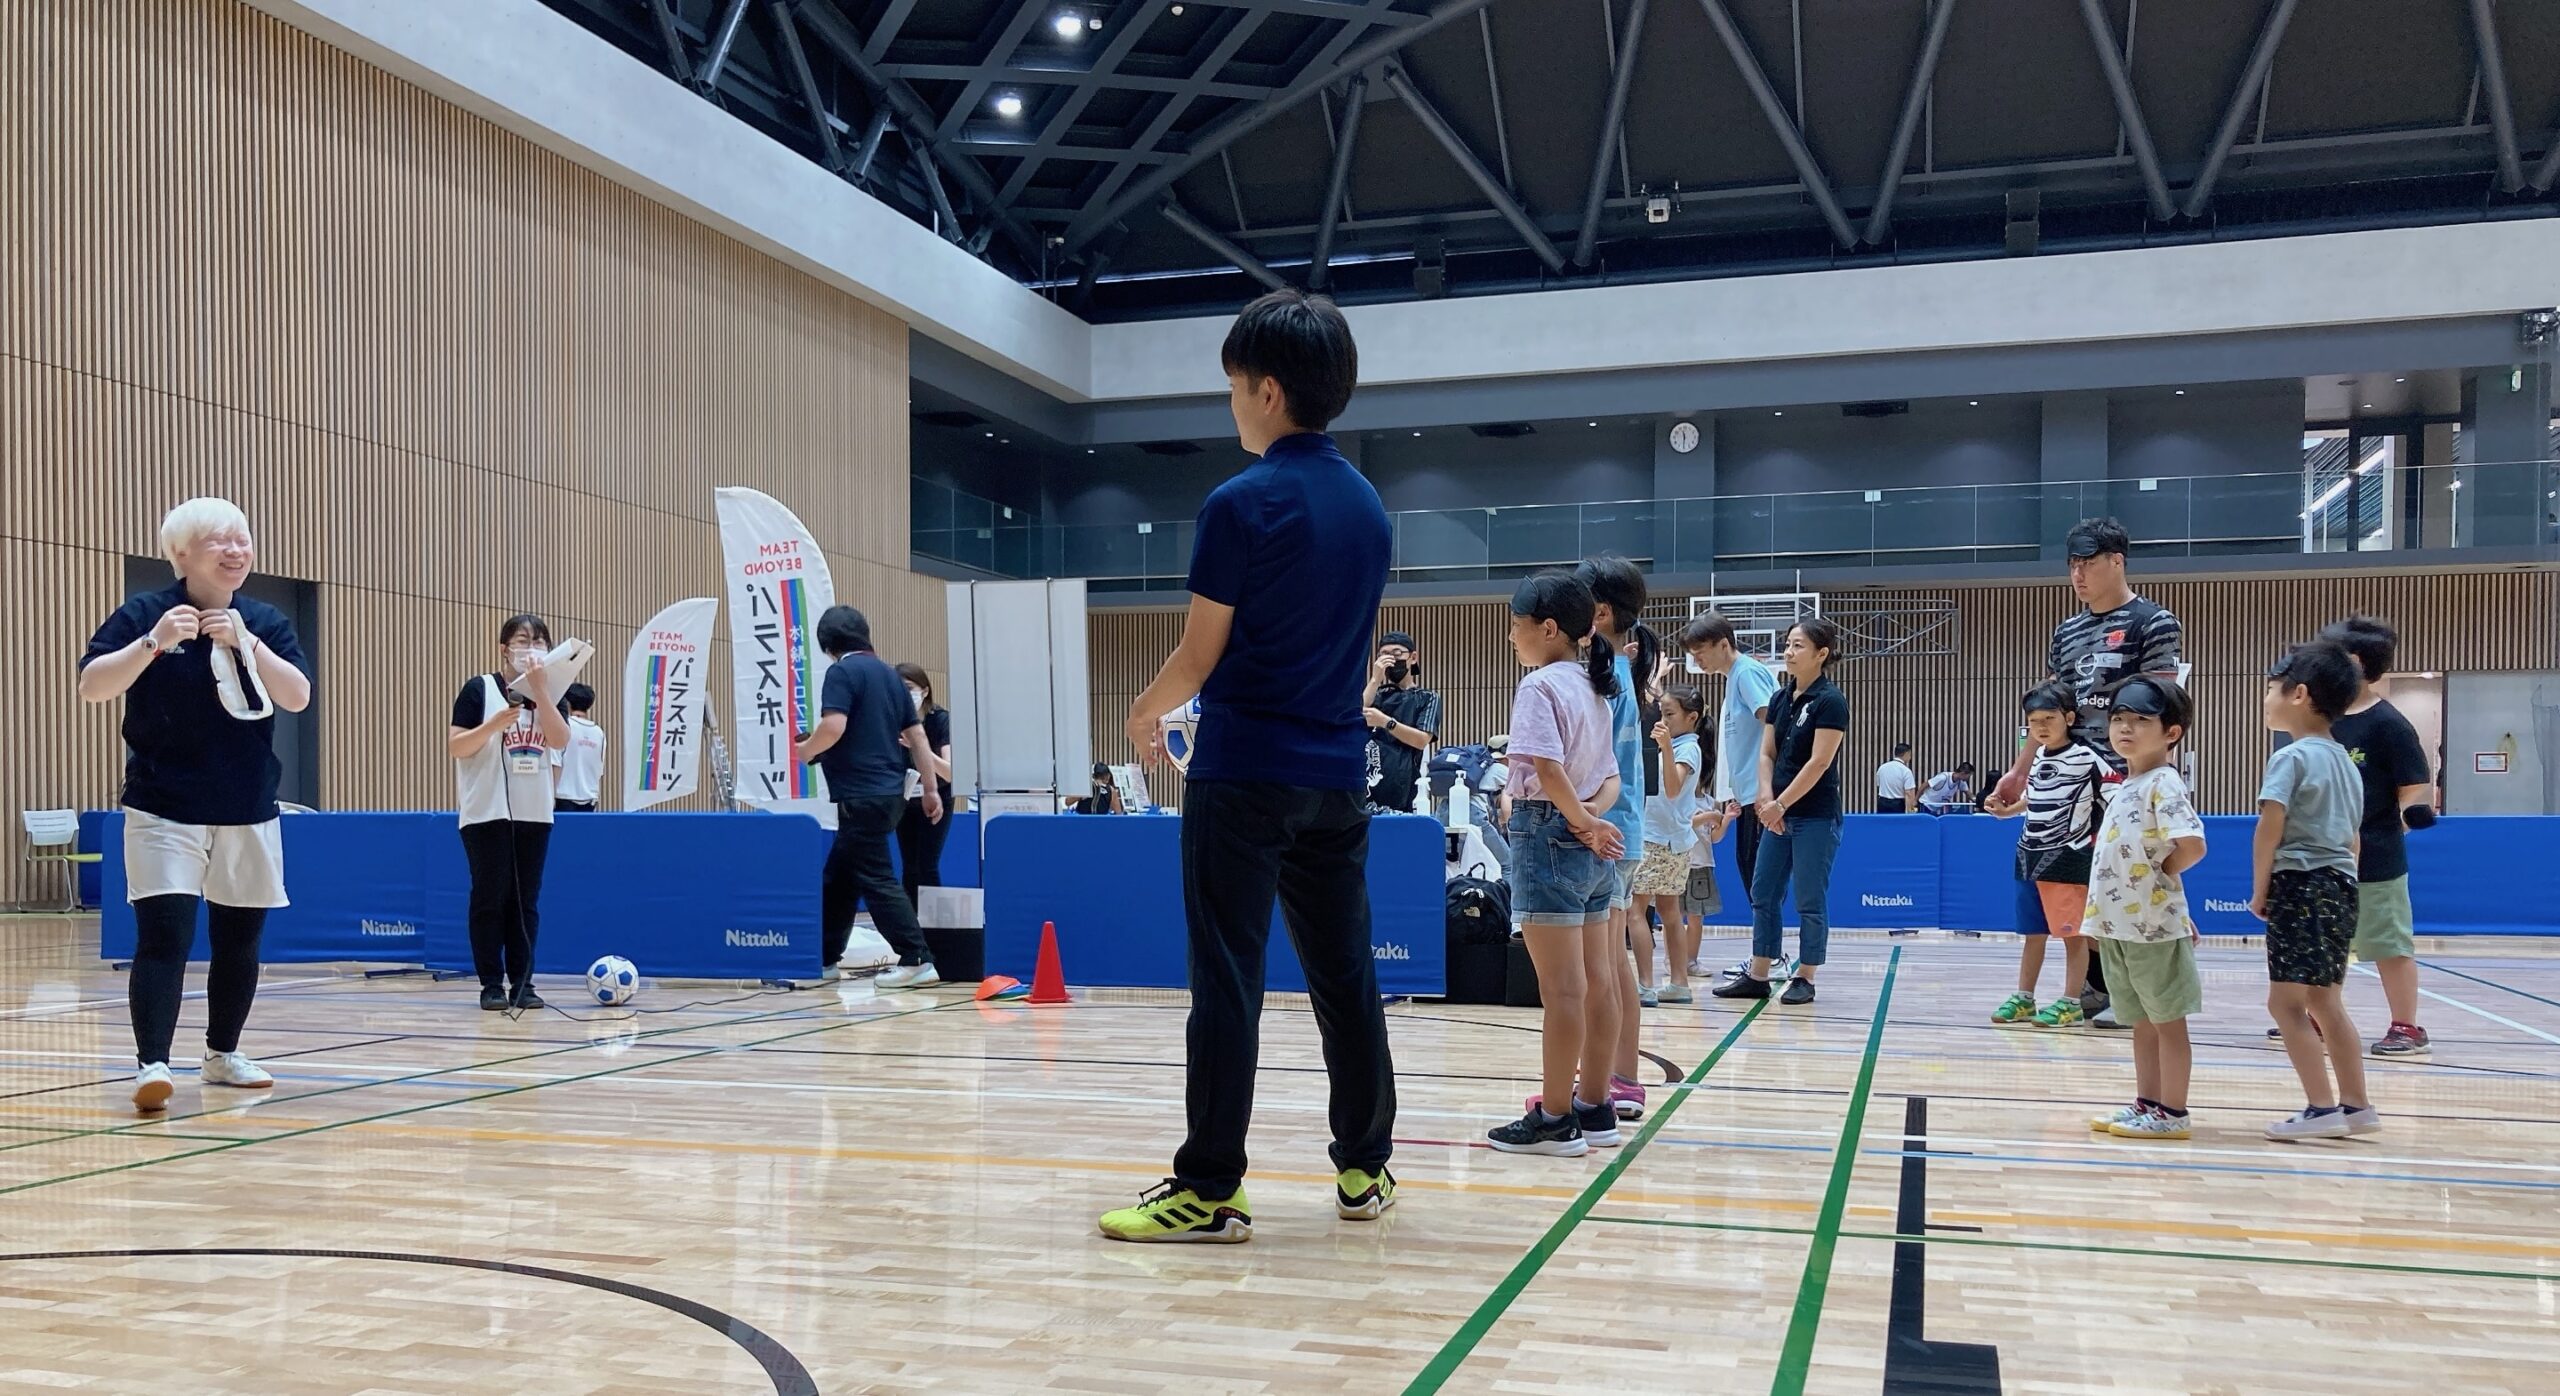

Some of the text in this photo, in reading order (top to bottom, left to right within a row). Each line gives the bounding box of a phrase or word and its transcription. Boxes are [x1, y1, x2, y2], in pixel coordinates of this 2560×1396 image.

[652, 631, 683, 642] TEAM
[650, 642, 696, 654] BEYOND
[662, 657, 695, 792] パラスポーツ
[1861, 893, 1914, 907] Nittaku
[2204, 898, 2253, 912] Nittak
[361, 919, 416, 936] Nittaku
[726, 929, 790, 947] Nittaku
